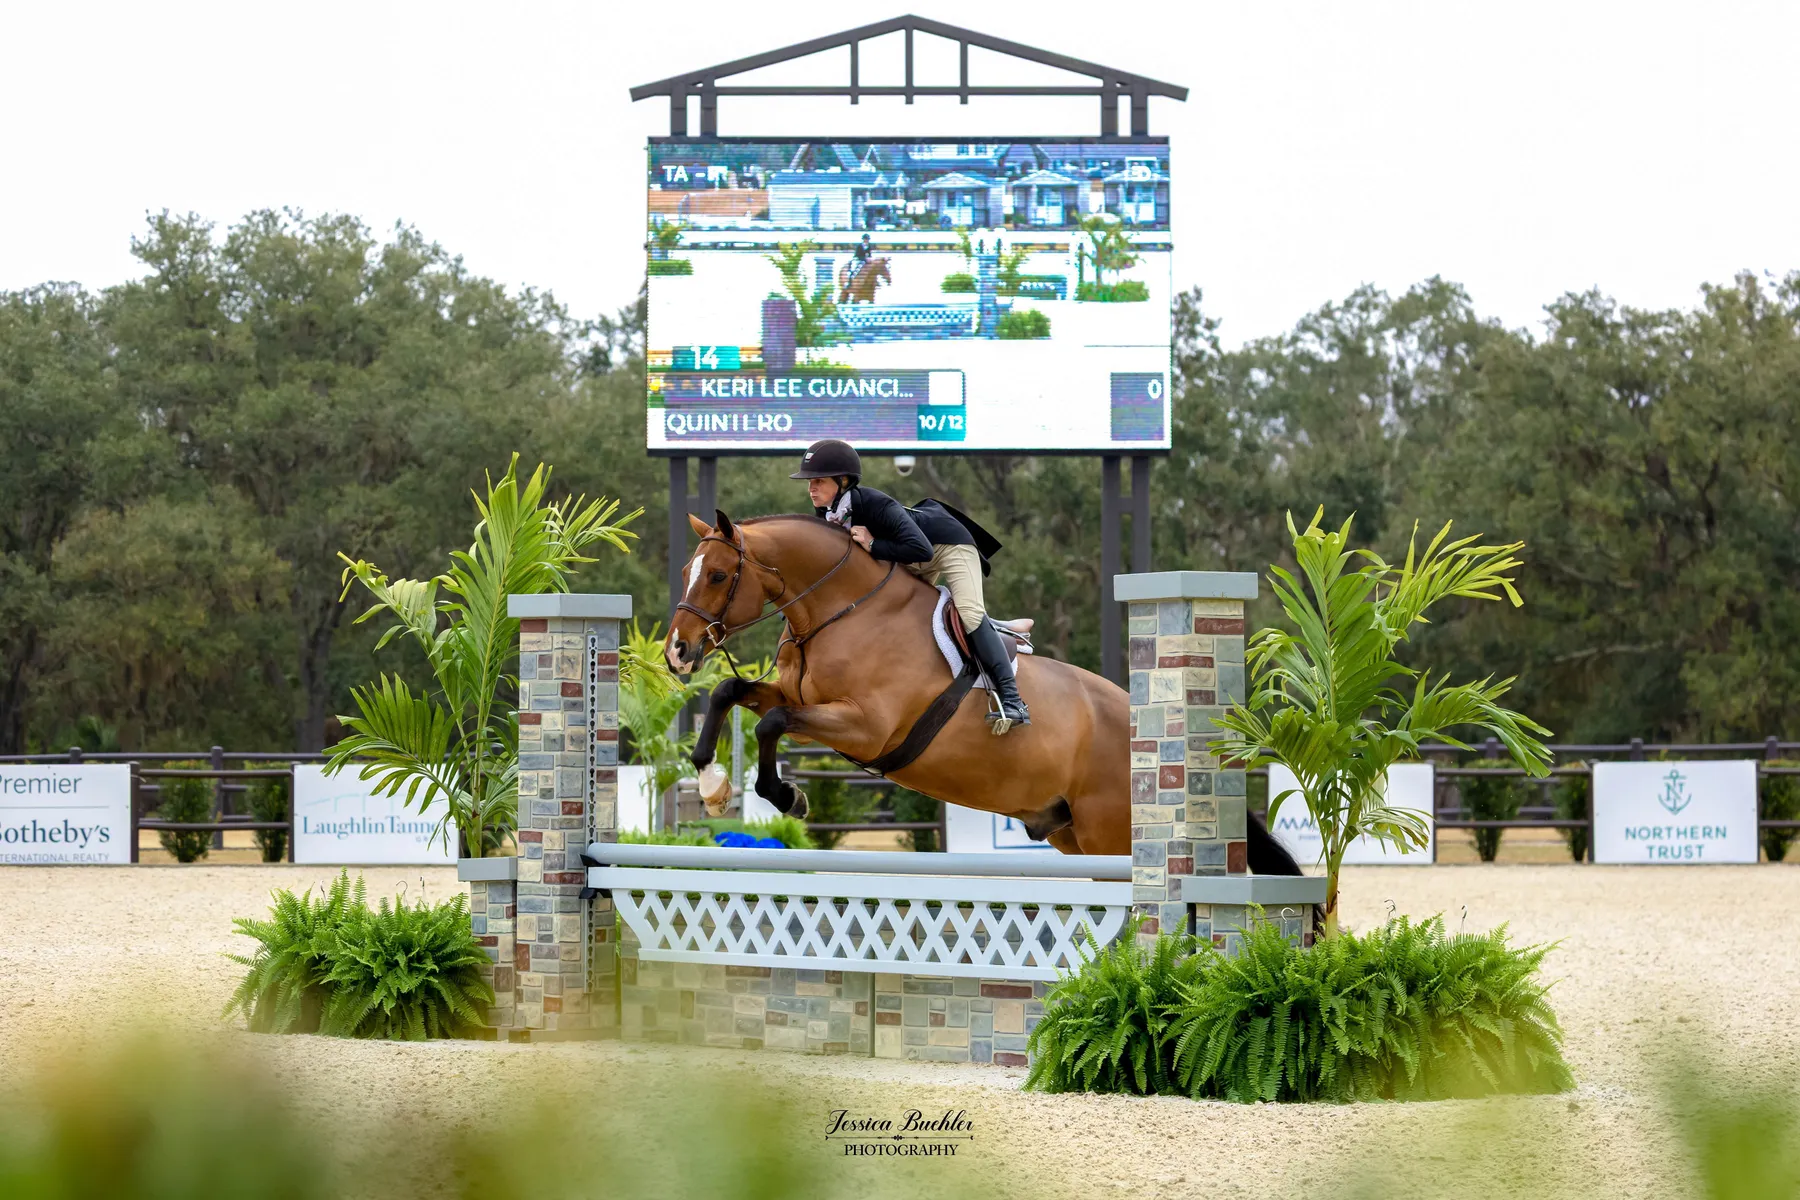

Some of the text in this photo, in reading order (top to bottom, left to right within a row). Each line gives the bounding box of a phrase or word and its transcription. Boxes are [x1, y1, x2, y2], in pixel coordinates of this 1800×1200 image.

[690, 345, 720, 370] 14
[701, 378, 754, 398] KERI
[760, 378, 802, 398] LEE
[0, 773, 82, 794] remier
[0, 819, 110, 849] otheby's
[1625, 826, 1727, 841] NORTHERN
[1646, 845, 1705, 860] TRUST
